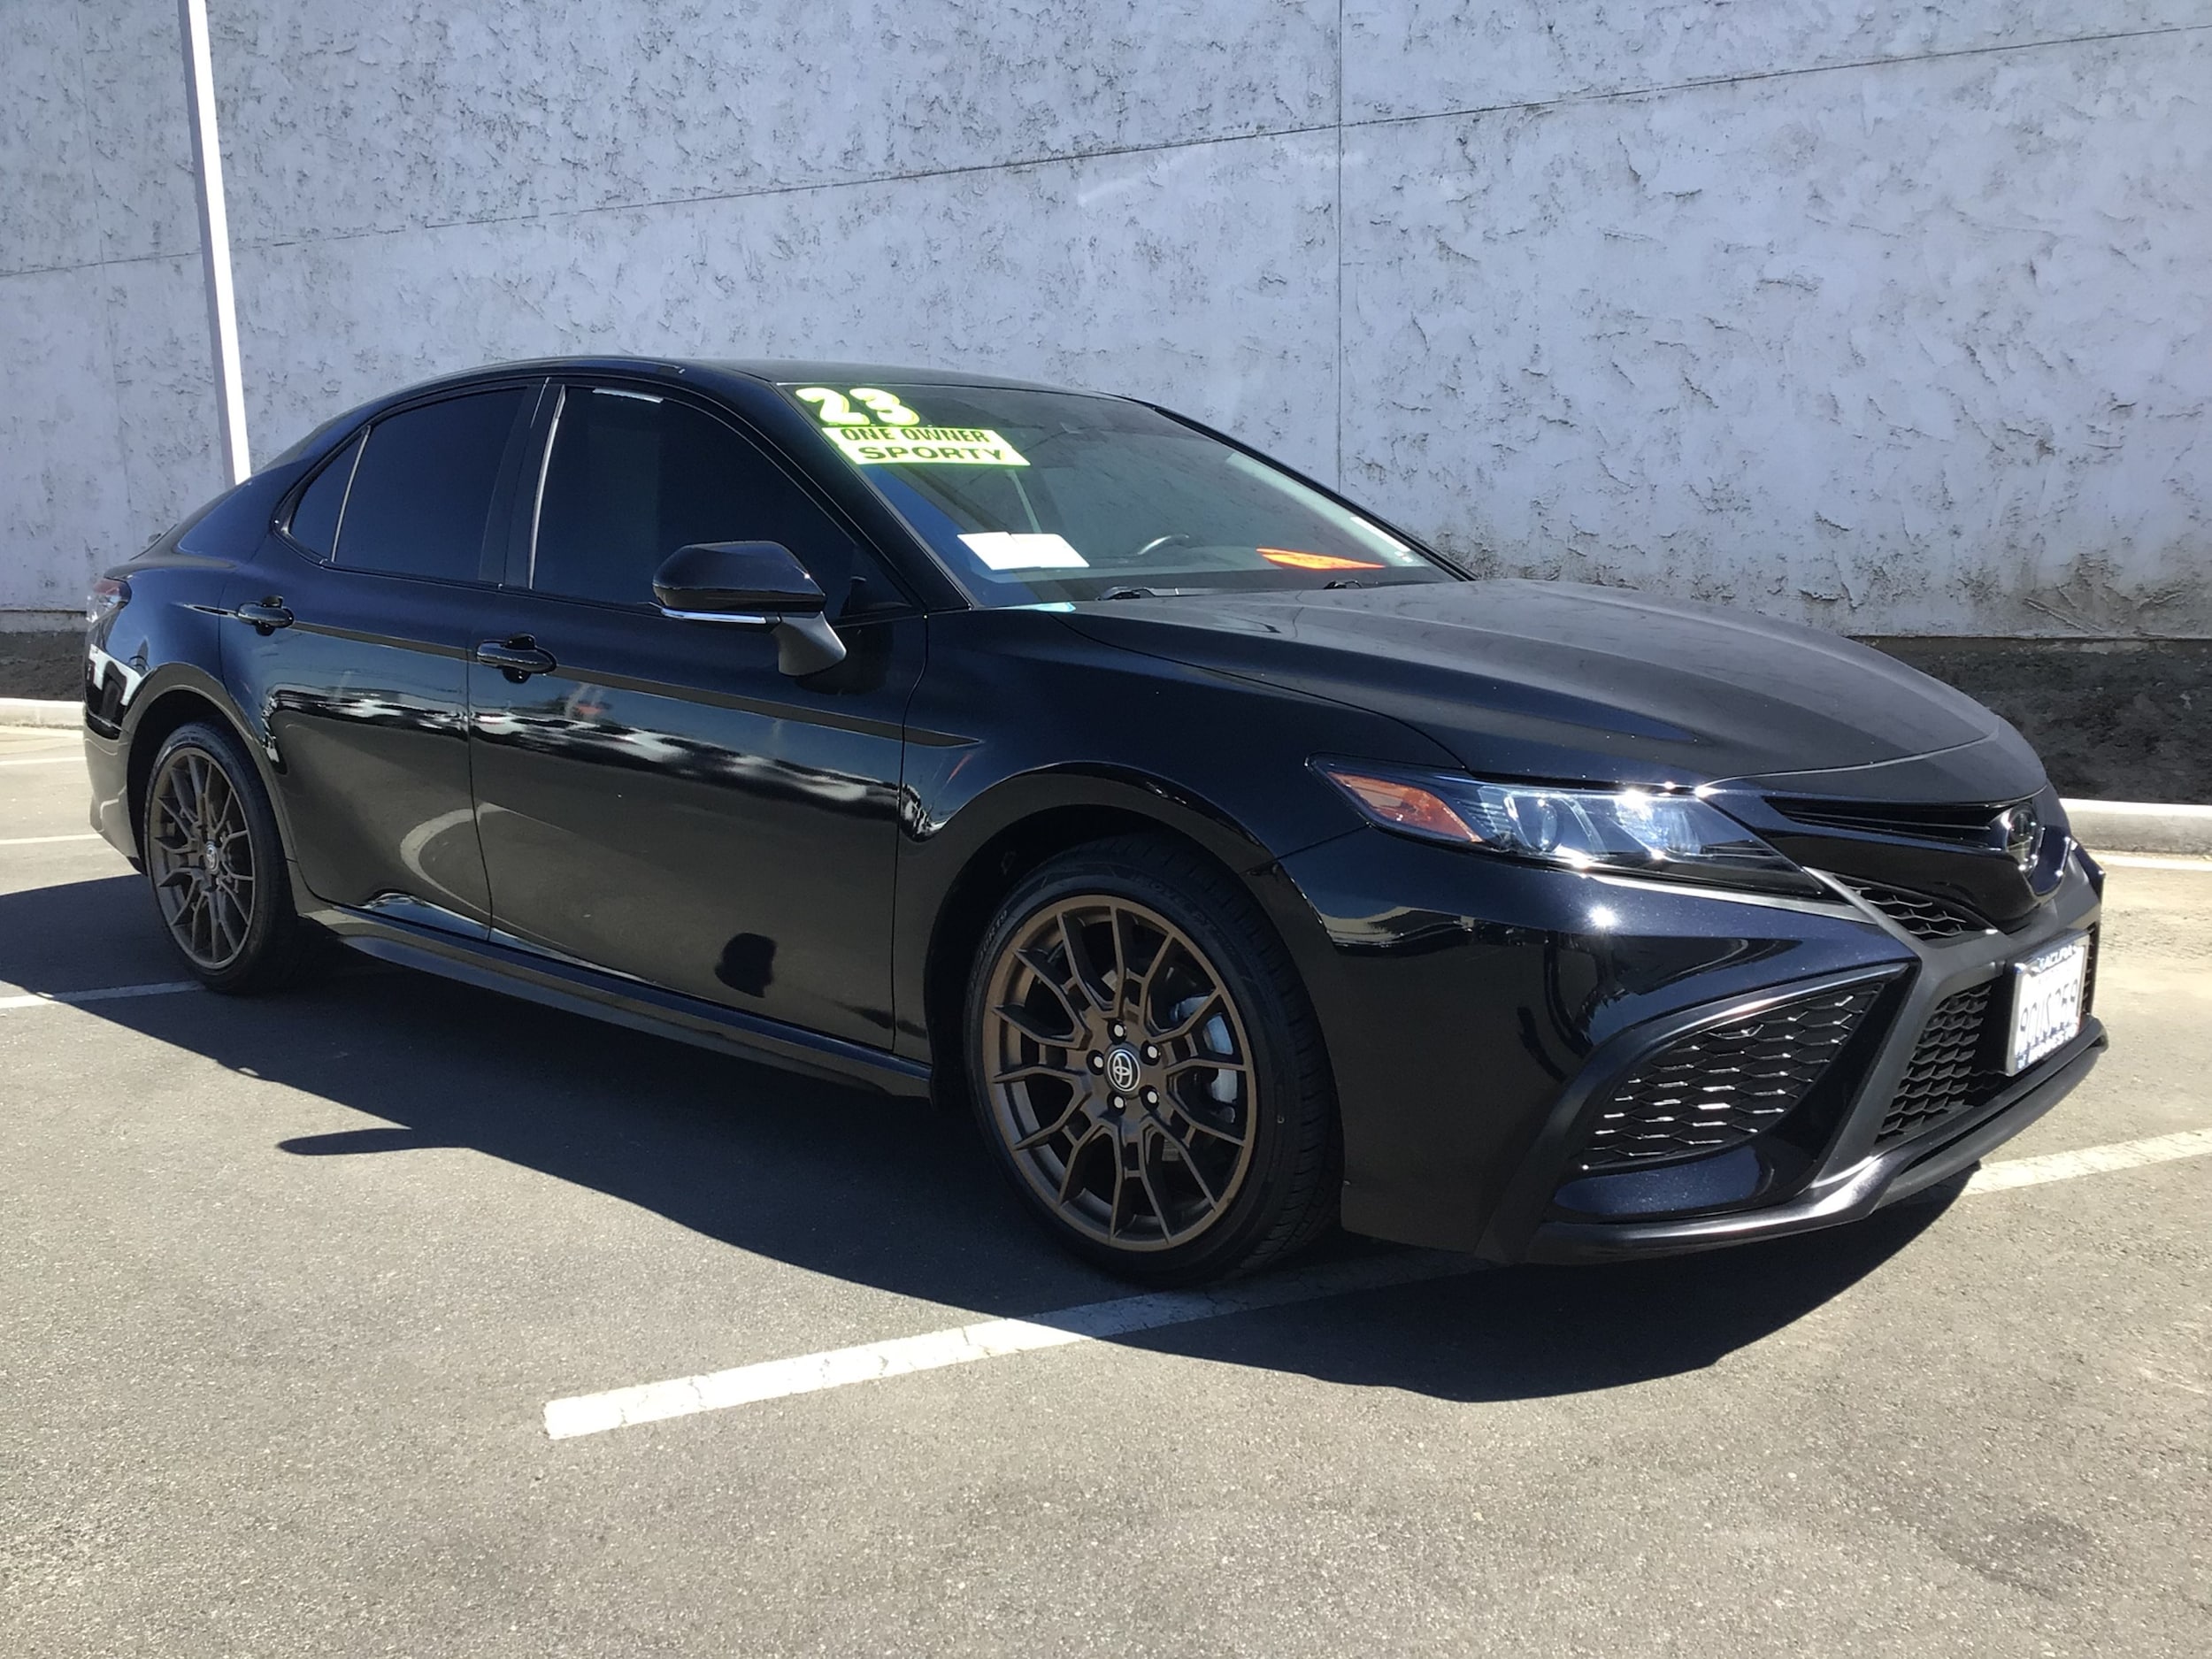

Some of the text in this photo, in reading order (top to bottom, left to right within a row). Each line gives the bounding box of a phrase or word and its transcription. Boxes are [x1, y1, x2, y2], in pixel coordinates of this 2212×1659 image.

[795, 388, 920, 426] 23
[841, 428, 990, 443] ONE OWNER
[857, 446, 1002, 461] SPORTY
